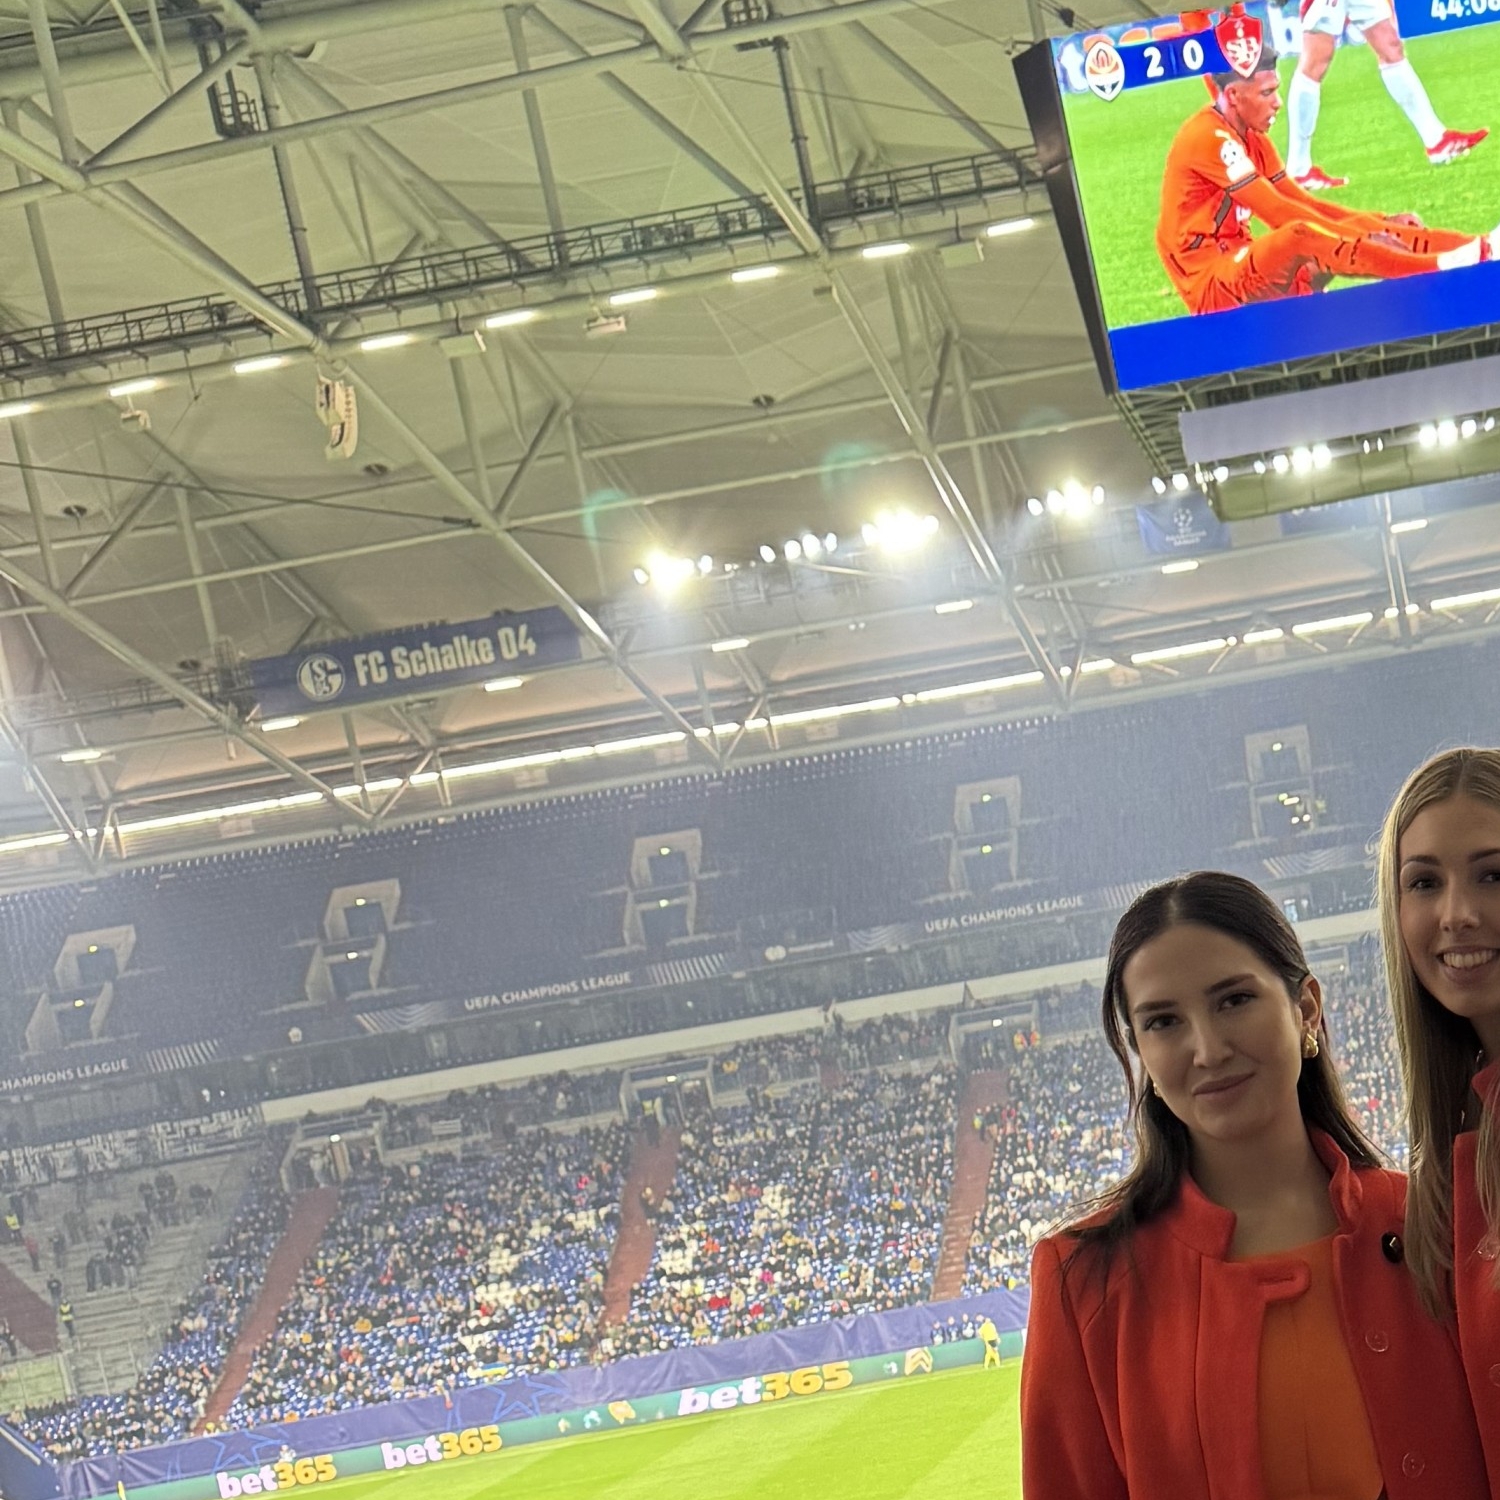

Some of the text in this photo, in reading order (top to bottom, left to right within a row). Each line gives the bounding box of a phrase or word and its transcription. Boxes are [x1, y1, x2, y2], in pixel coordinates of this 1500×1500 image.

[1143, 39, 1204, 77] 2 0
[354, 624, 536, 686] FC Schalke 04
[925, 895, 1084, 933] UEFA CHAMPIONS LEAGUE
[464, 972, 631, 1010] UEFA CHAMPIONS LEAGUE
[76, 1058, 129, 1078] LEAGUE
[677, 1361, 853, 1416] bet365
[380, 1424, 503, 1470] bet365
[216, 1454, 337, 1499] bet365
